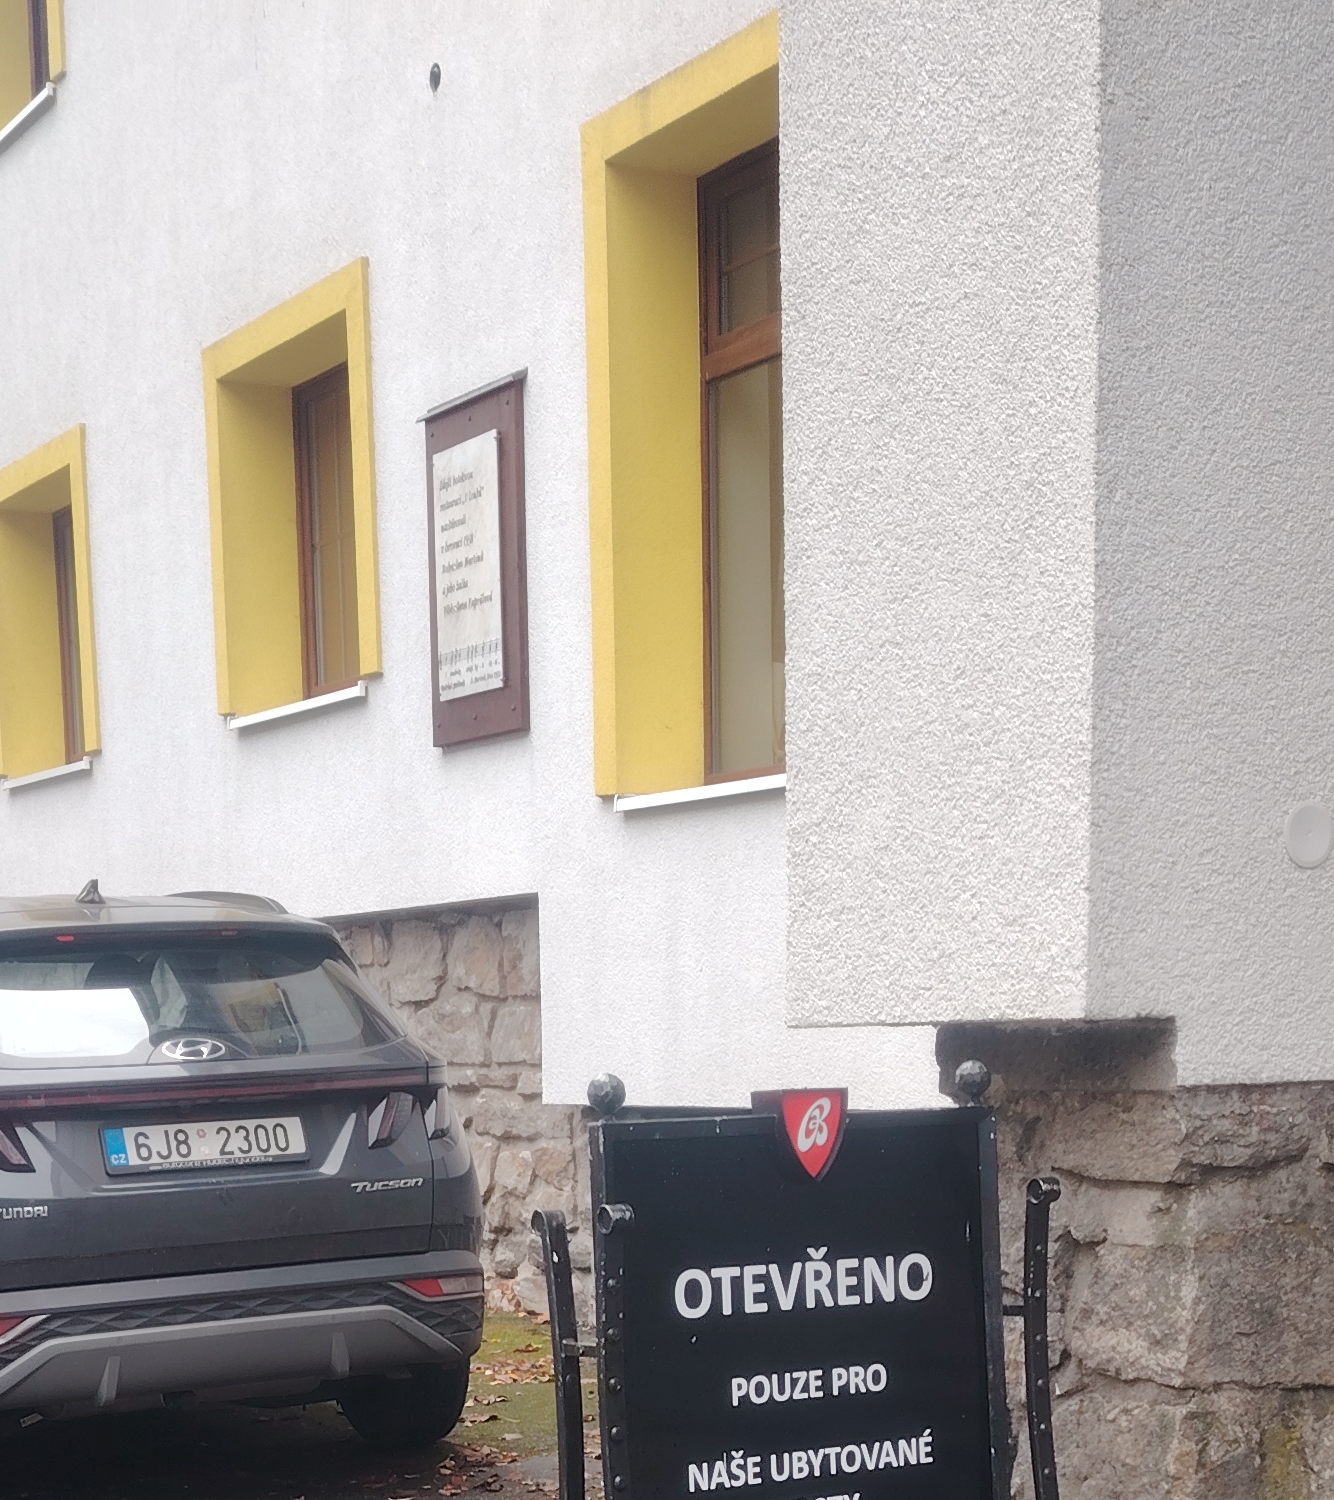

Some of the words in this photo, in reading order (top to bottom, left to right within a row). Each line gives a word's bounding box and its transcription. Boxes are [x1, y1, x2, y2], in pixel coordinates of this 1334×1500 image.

[110, 1155, 128, 1165] CZ
[134, 1129, 192, 1162] 6J8
[216, 1123, 289, 1157] 2300
[674, 1247, 934, 1319] OTEVŘENO
[730, 1369, 824, 1406] POUZE
[832, 1363, 888, 1396] PRO
[687, 1449, 762, 1493] NAŠE
[770, 1428, 934, 1483] UBYTOVANÉ
